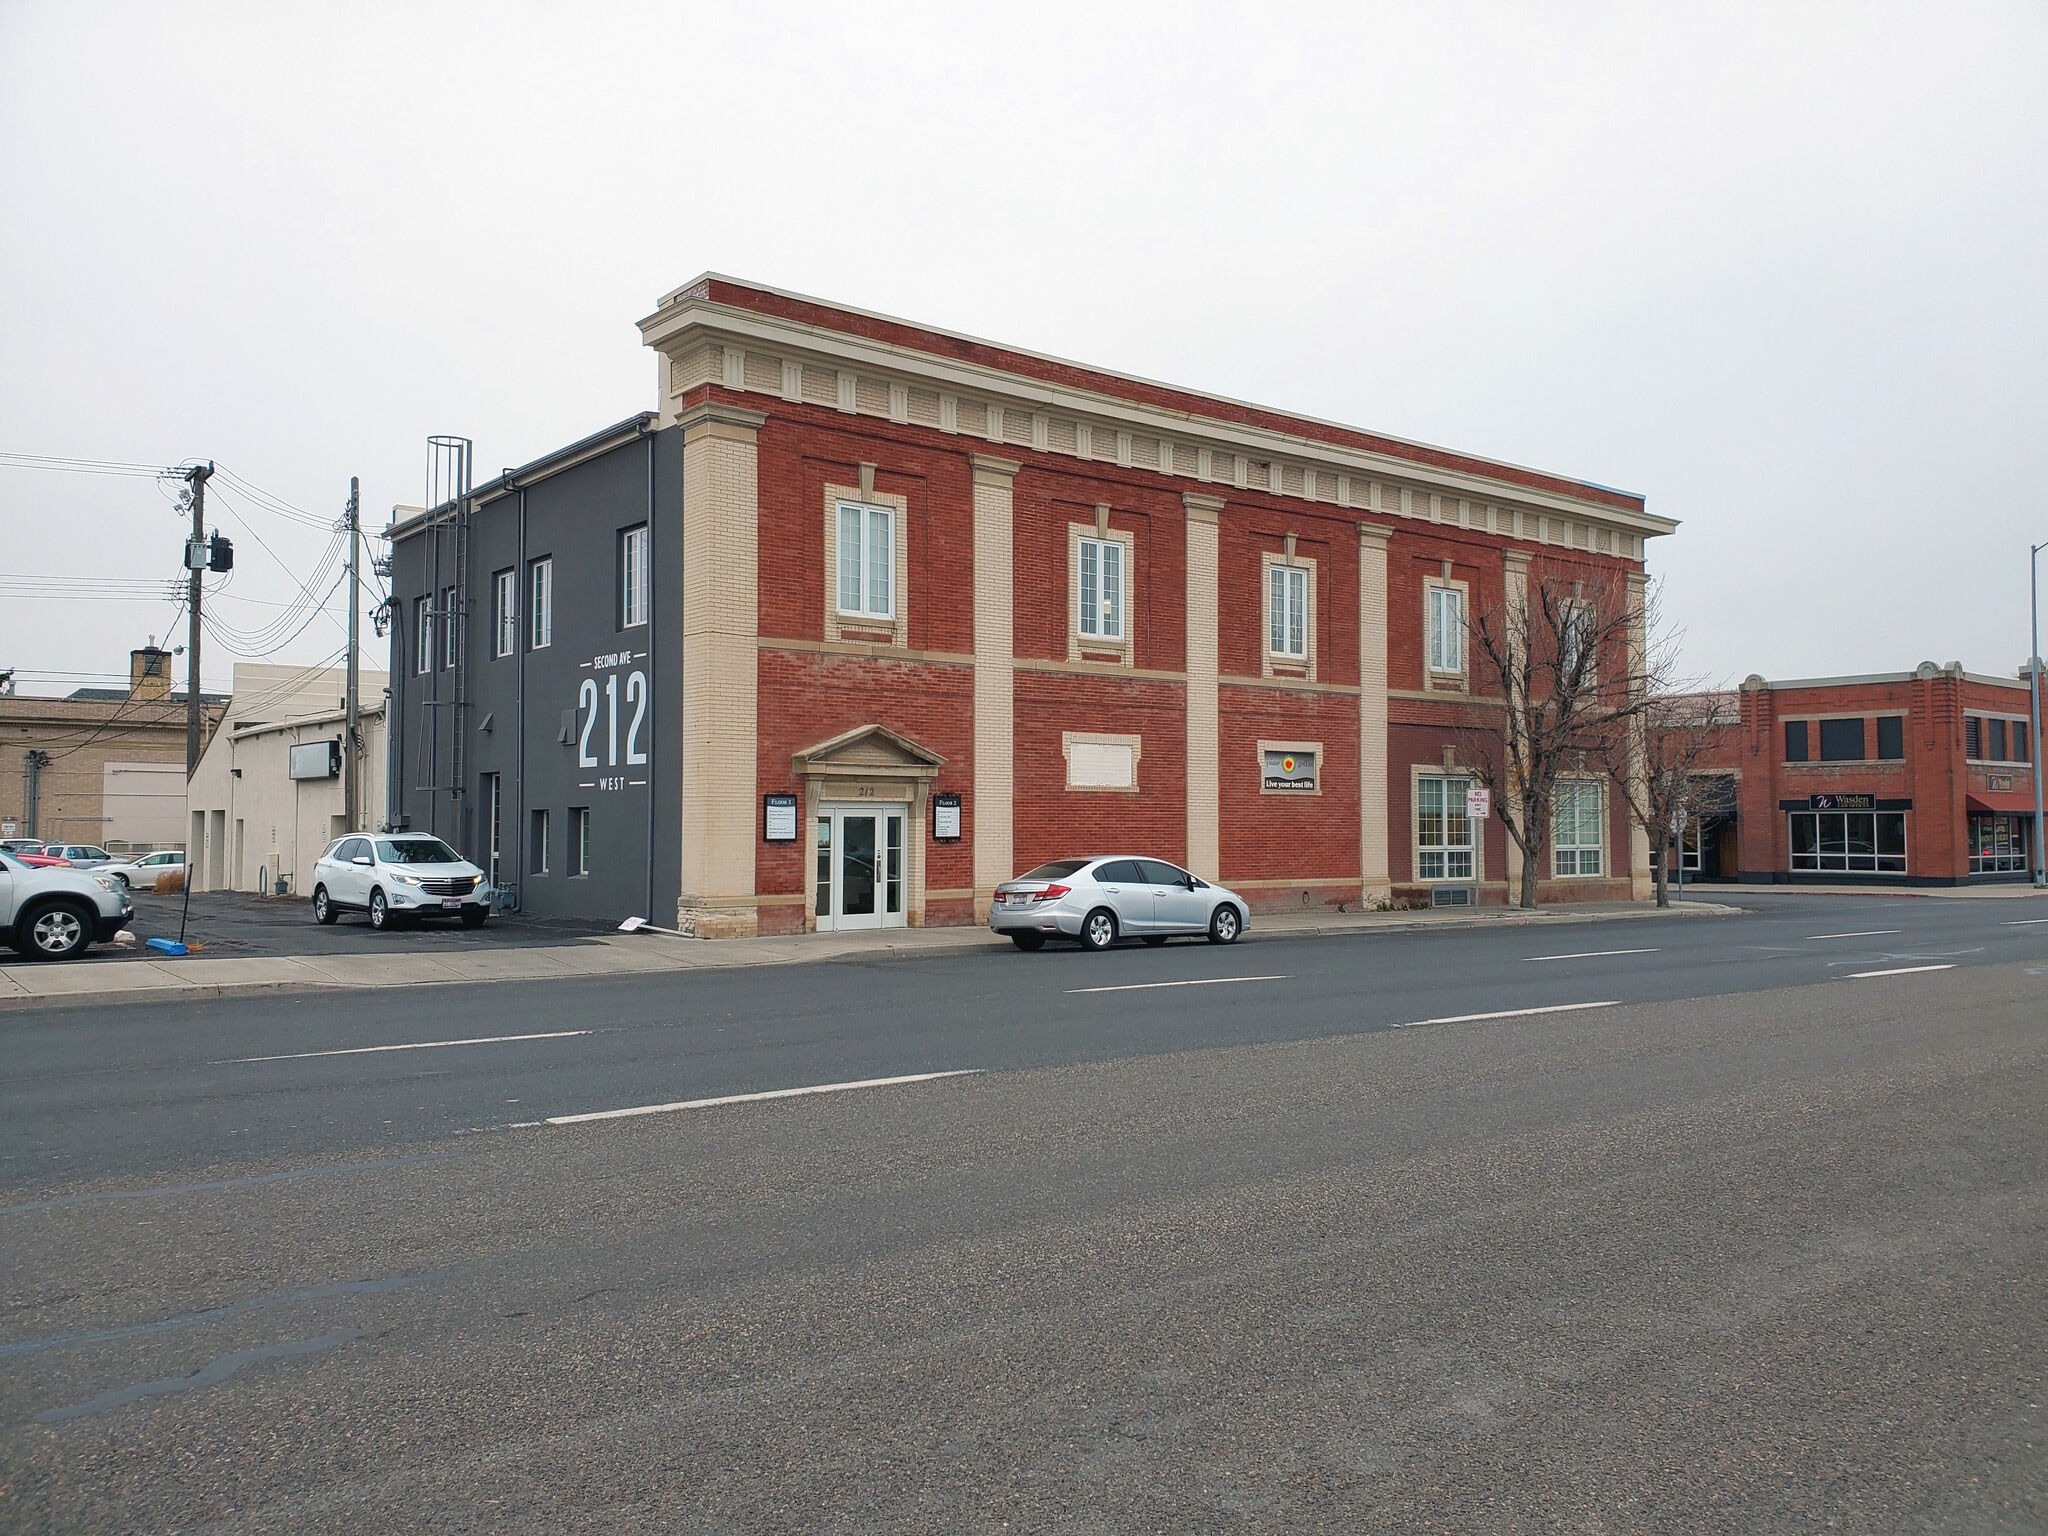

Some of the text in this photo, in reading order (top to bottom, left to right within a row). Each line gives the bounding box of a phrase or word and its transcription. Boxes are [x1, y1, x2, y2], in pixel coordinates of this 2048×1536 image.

[593, 650, 632, 670] SECOND AVE
[579, 670, 647, 768] 212
[599, 777, 624, 790] WEST
[859, 787, 875, 796] 212
[1835, 795, 1868, 803] Wasden
